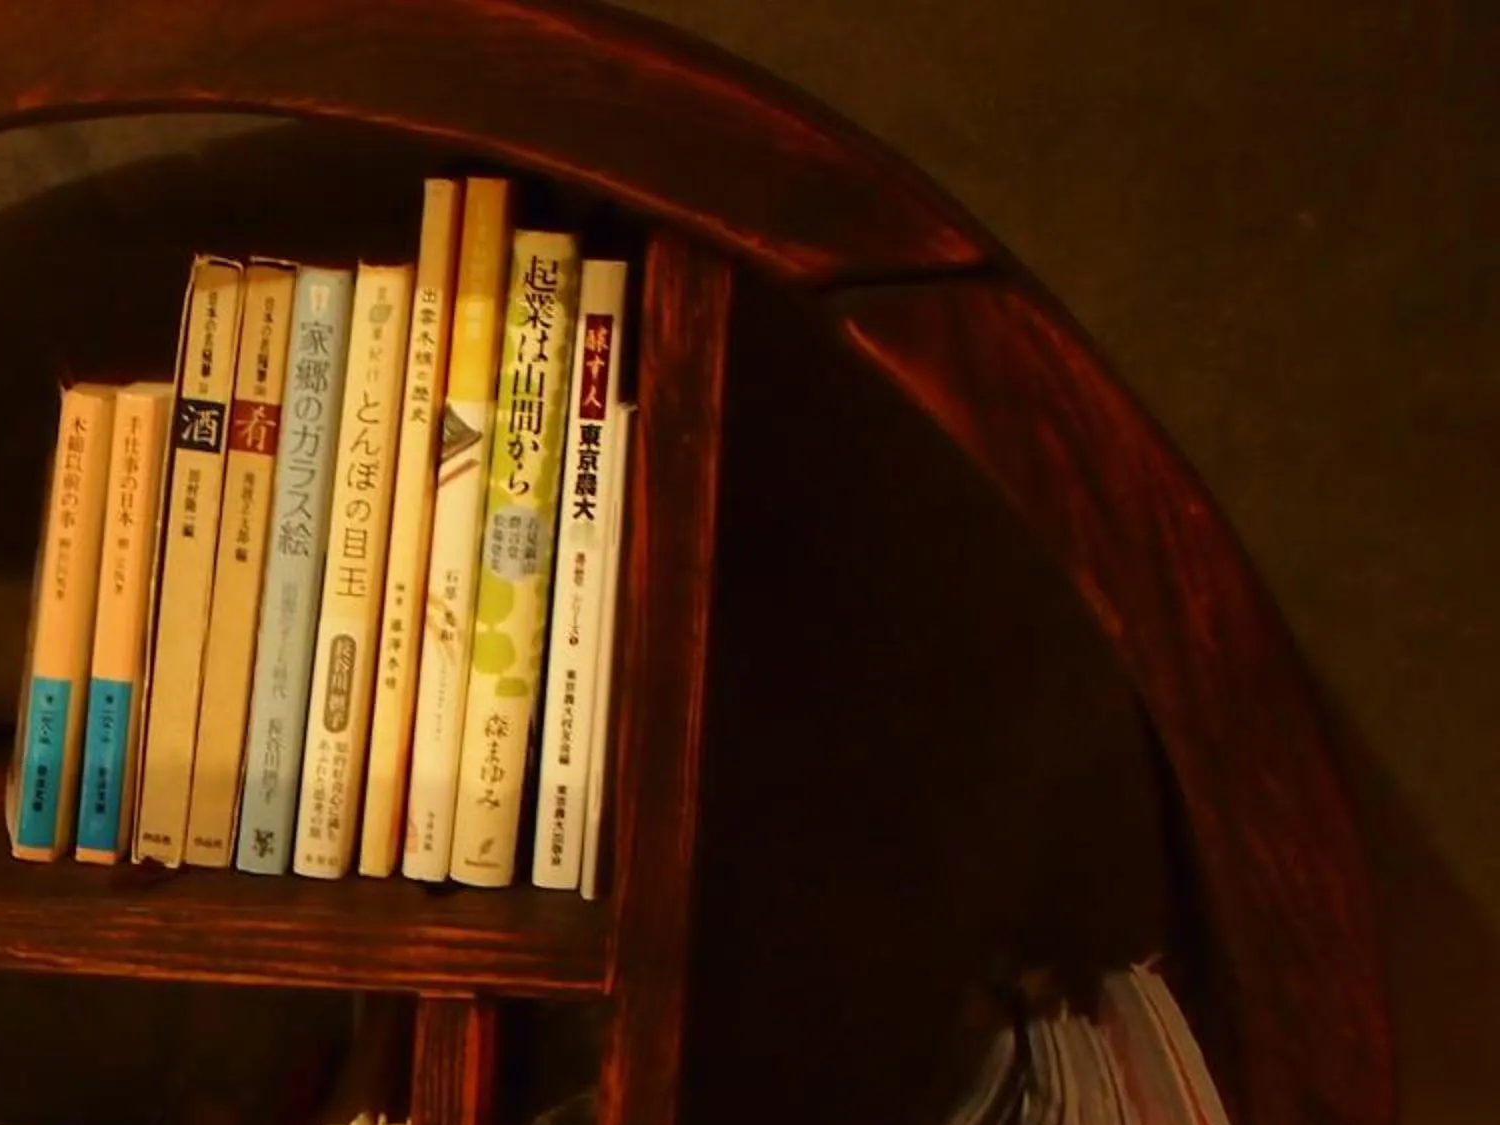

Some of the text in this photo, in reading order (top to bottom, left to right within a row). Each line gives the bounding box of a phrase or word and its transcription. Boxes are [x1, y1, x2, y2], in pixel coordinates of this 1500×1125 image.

[181, 405, 217, 447] 酒
[506, 255, 560, 499] 起業は山間から
[235, 406, 276, 451] 肴
[279, 321, 334, 558] 家郷のガラス絵
[573, 424, 602, 521] 東京農大
[336, 391, 382, 598] とんぼの目玉
[477, 714, 510, 812] 森まゆみ
